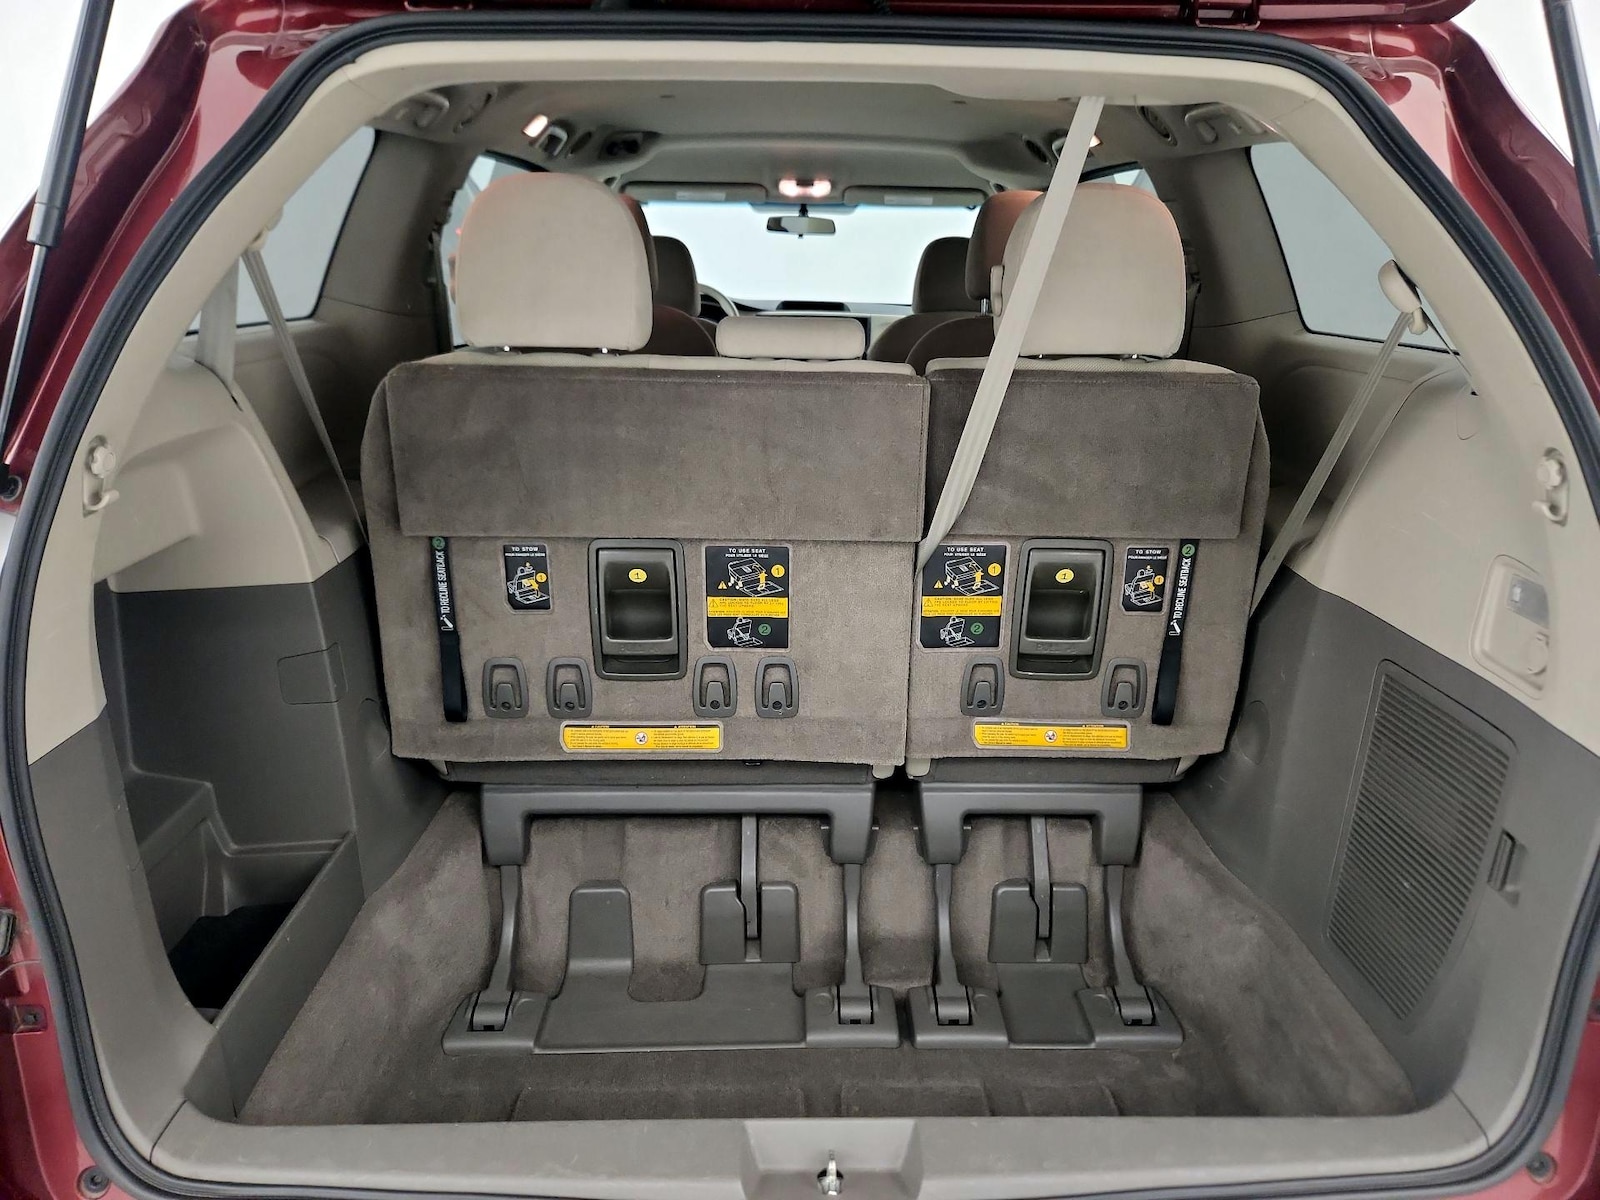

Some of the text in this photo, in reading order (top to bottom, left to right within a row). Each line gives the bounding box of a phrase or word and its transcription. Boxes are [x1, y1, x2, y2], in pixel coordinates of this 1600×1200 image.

[438, 582, 450, 605] RECLINE
[1172, 557, 1192, 619] TO RECLINE SEATBACK
[440, 605, 451, 614] TO
